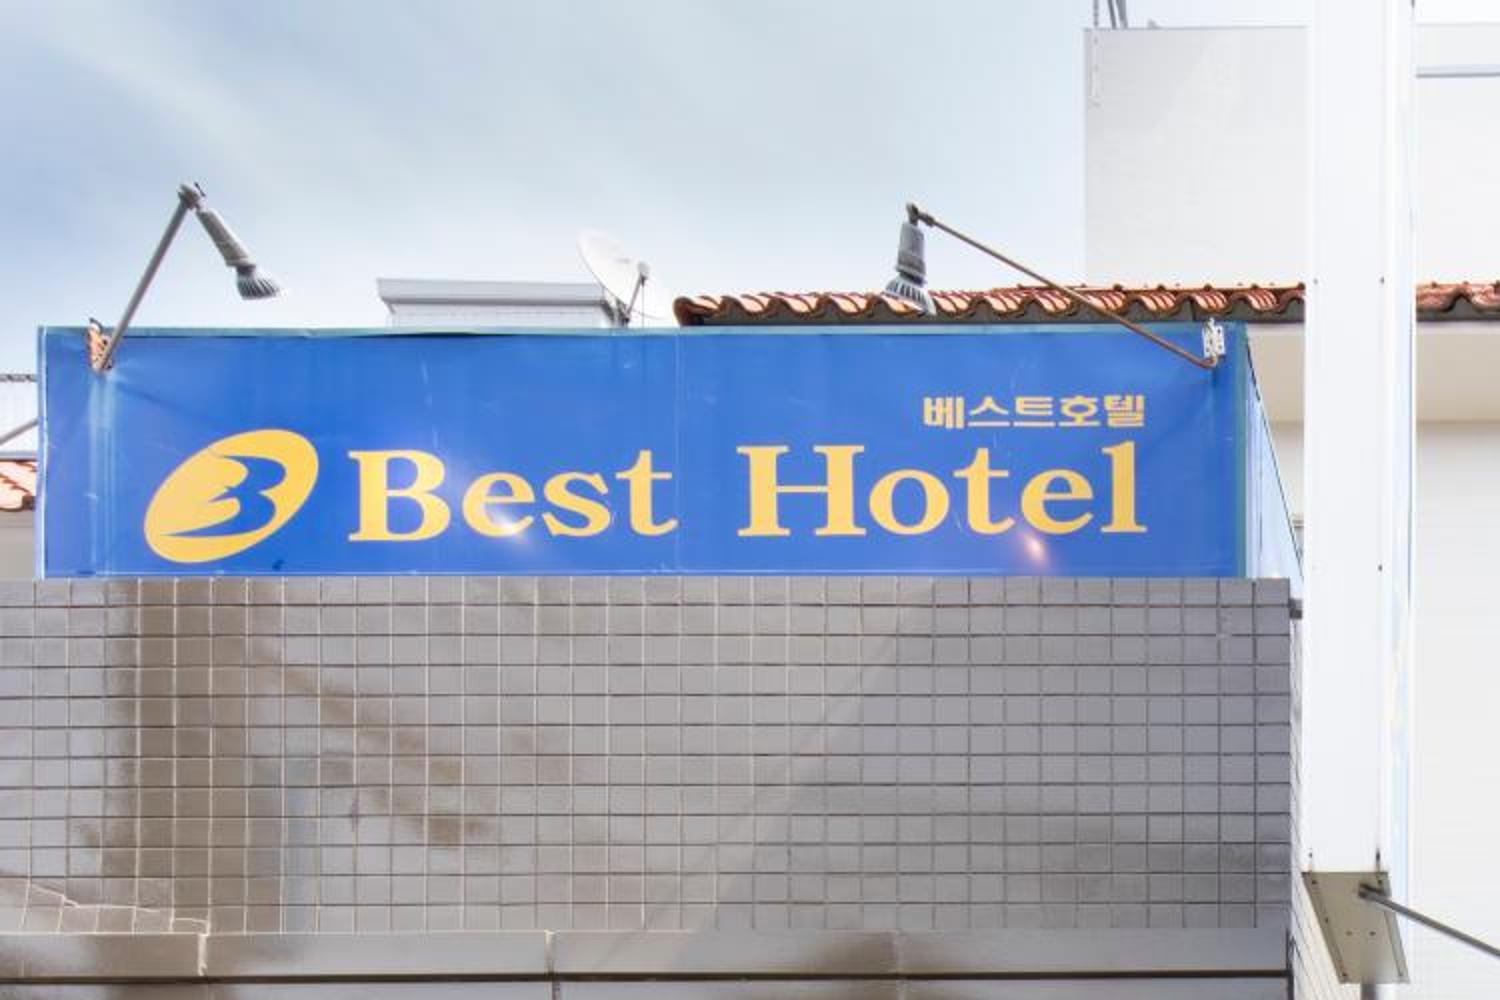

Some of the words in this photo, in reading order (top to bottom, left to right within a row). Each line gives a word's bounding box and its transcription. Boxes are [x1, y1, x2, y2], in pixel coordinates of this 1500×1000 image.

[923, 394, 1145, 429] 베스트호텔
[348, 449, 679, 542] Best
[736, 440, 1149, 537] Hotel
